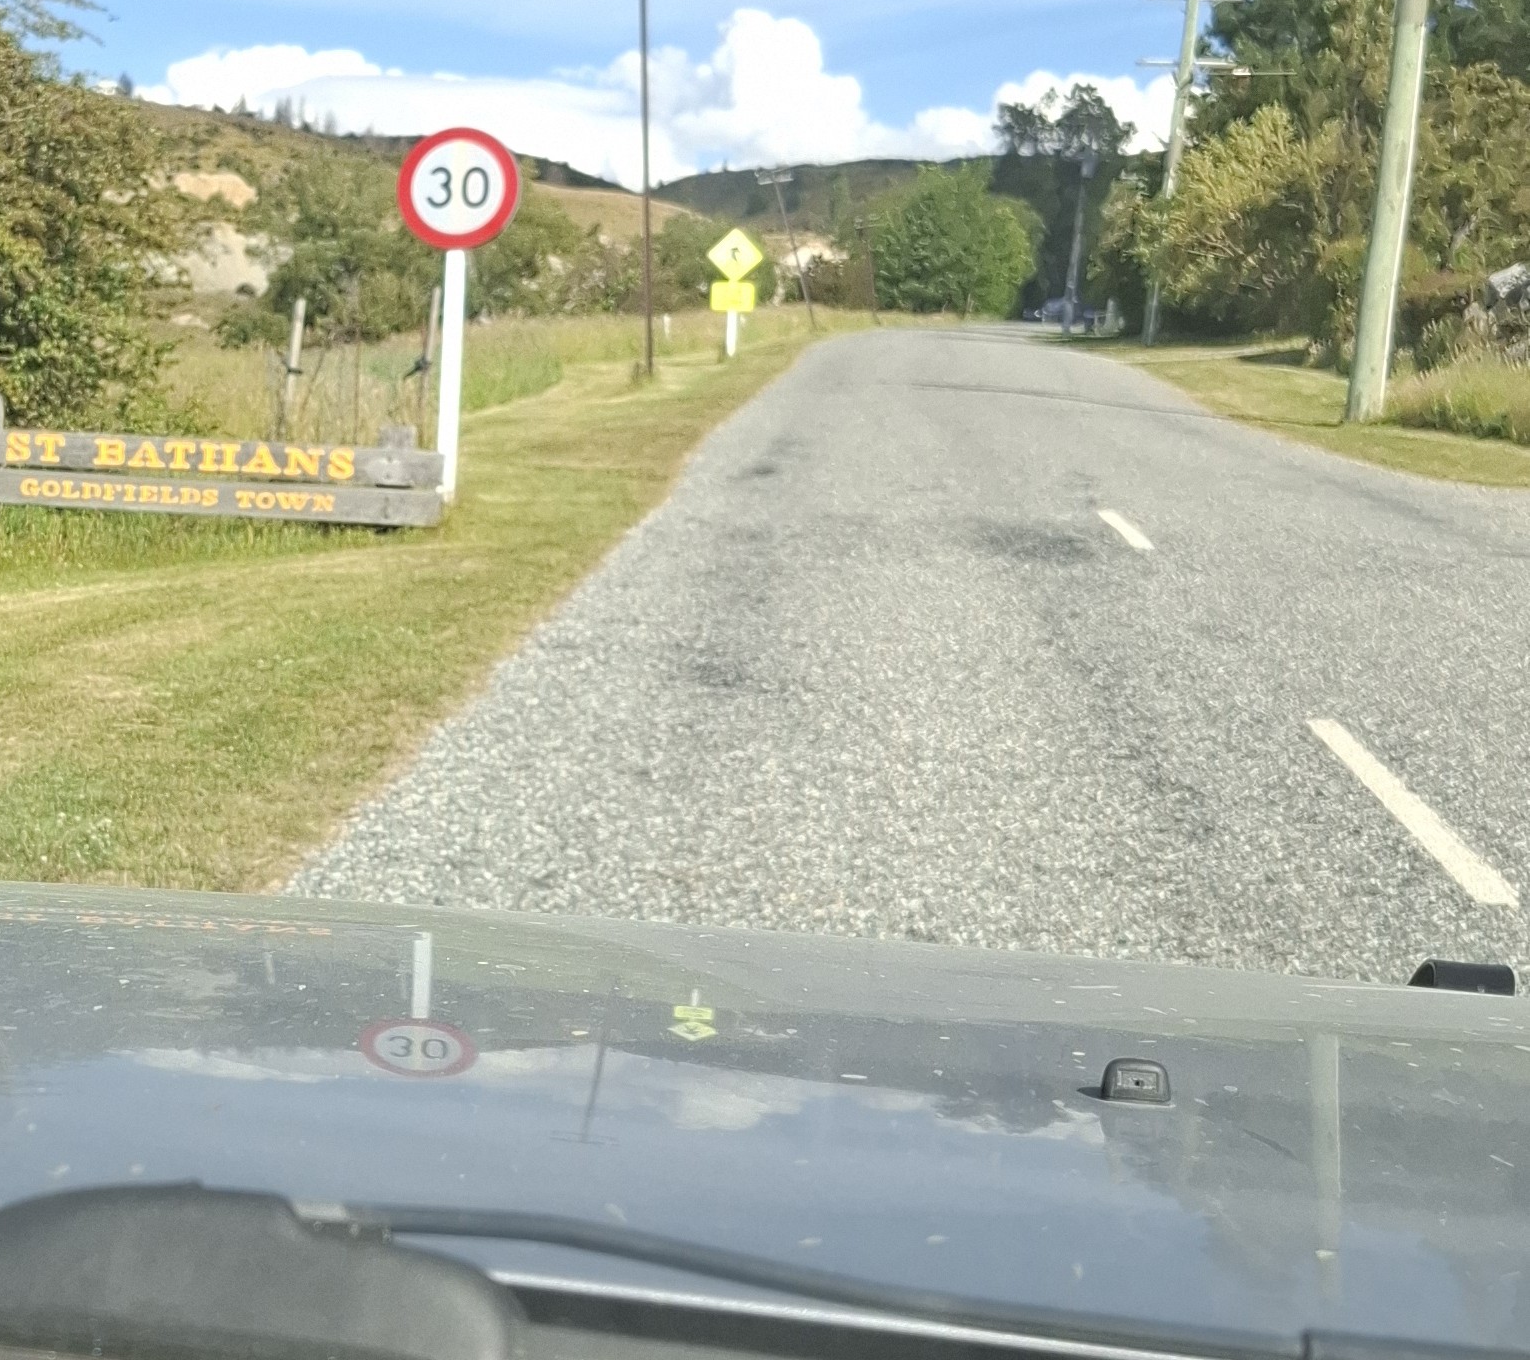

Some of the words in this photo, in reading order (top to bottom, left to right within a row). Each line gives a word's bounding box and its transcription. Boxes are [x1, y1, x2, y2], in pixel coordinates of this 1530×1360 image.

[426, 166, 489, 209] 30
[6, 432, 66, 463] ST
[93, 437, 355, 480] BATHANS
[20, 477, 218, 507] GOLDFIELDS
[235, 490, 335, 512] TOWN
